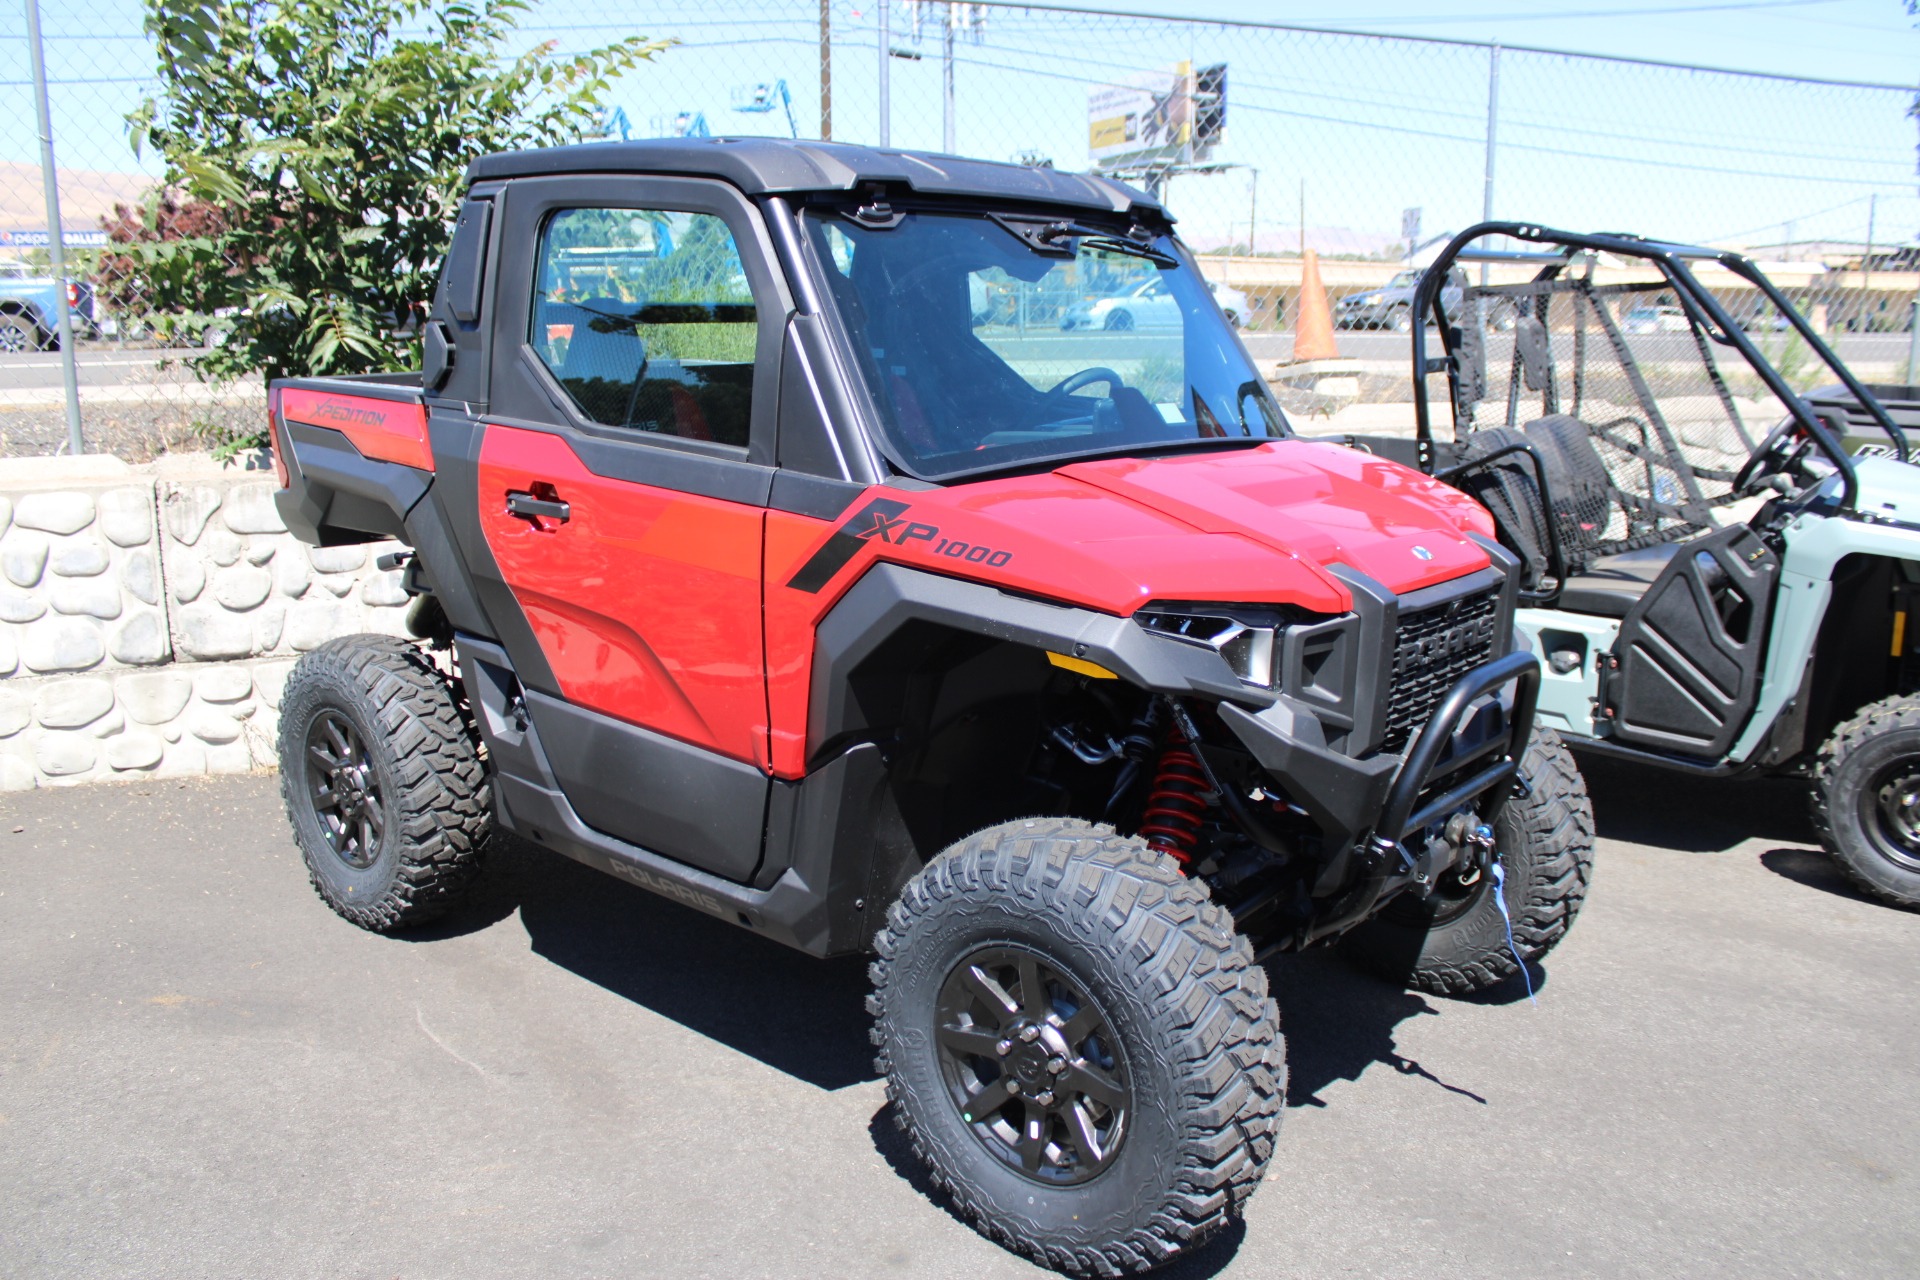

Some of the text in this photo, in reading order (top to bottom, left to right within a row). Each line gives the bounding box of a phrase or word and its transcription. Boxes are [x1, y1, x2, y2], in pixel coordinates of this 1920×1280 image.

[14, 232, 50, 247] peps
[308, 397, 388, 427] XPEDITION
[856, 512, 1014, 568] XP 1000
[1399, 612, 1497, 674] POLARIS
[608, 857, 723, 914] POLARIS
